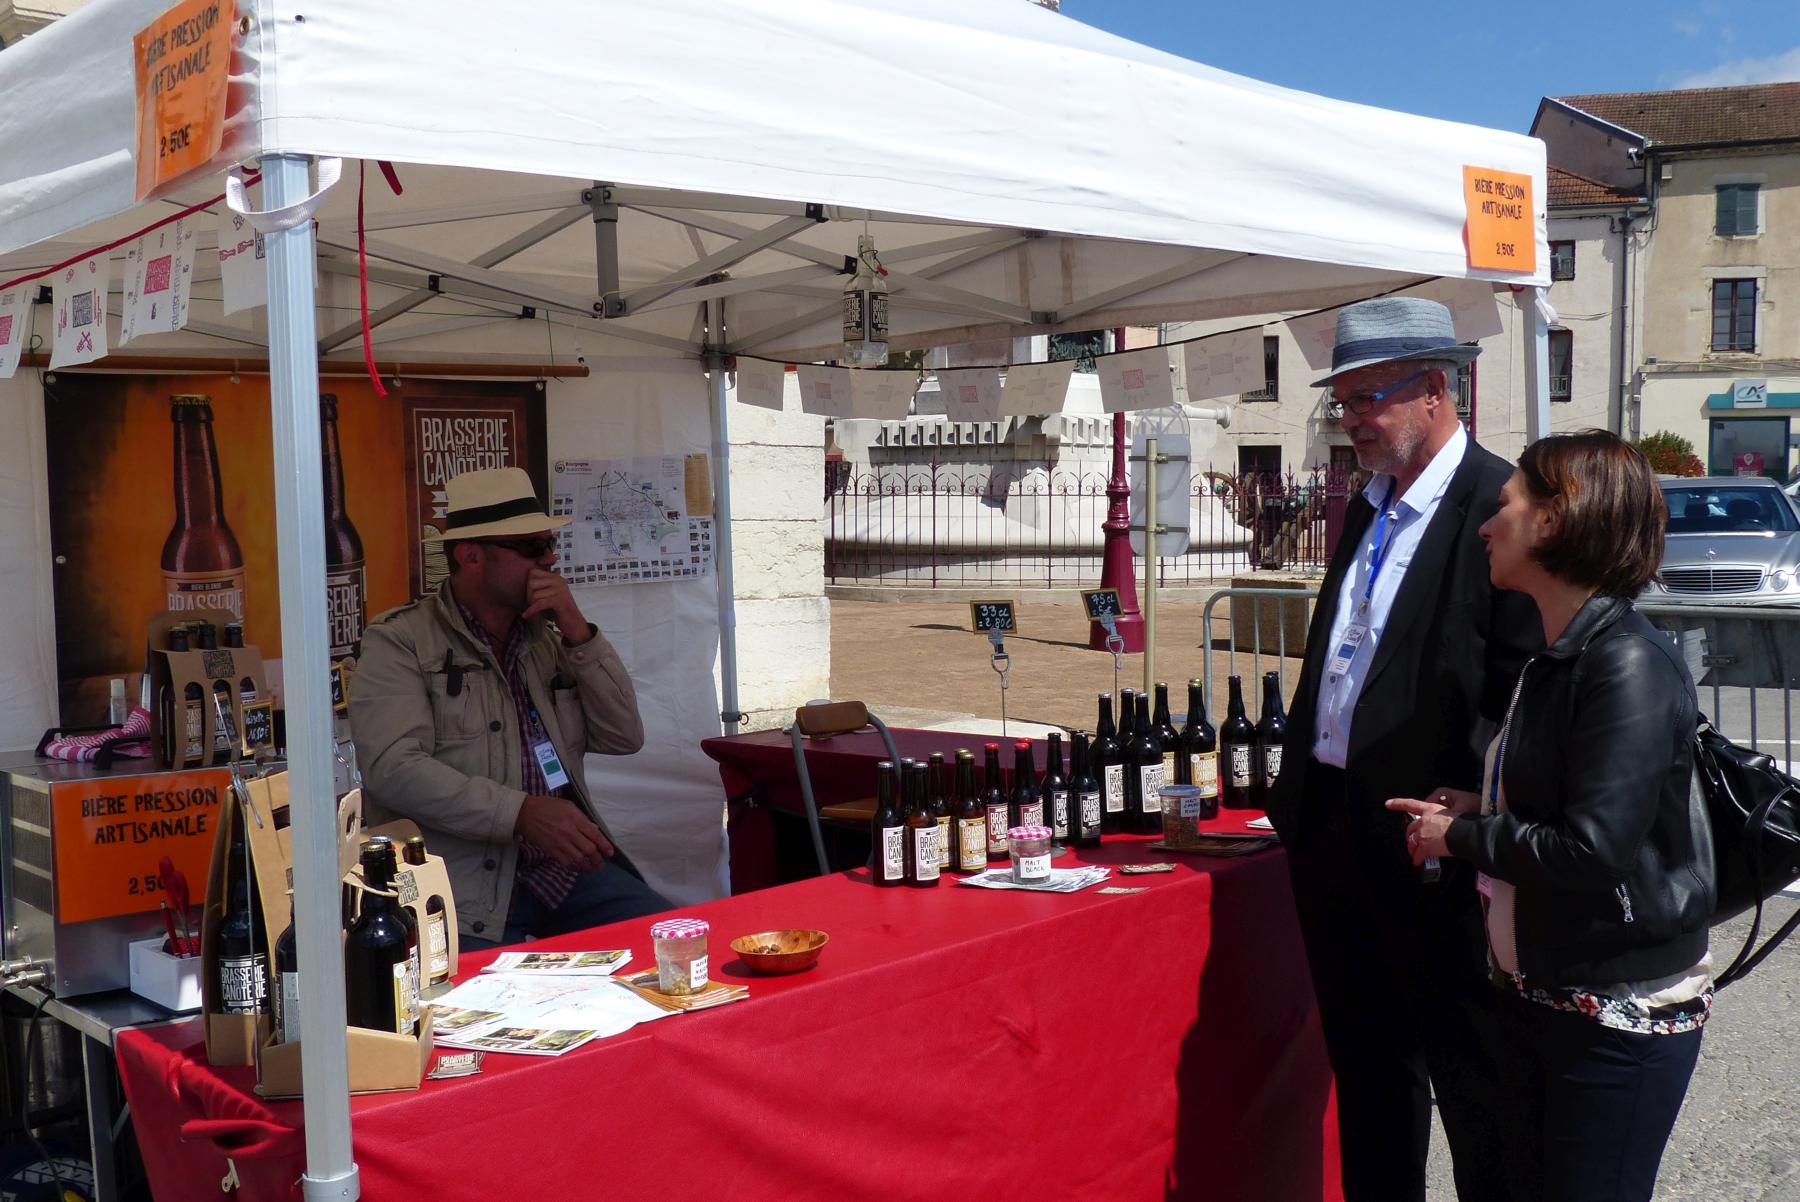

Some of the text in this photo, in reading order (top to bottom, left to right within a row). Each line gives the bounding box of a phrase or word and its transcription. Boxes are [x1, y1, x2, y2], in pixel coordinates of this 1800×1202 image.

[1495, 183, 1525, 200] PRESSION
[1482, 201, 1523, 219] ARTISANALE
[421, 417, 510, 451] BRASSERIE
[980, 605, 997, 617] 33
[135, 787, 218, 813] PRESSION
[95, 814, 207, 844] ARTISANALE
